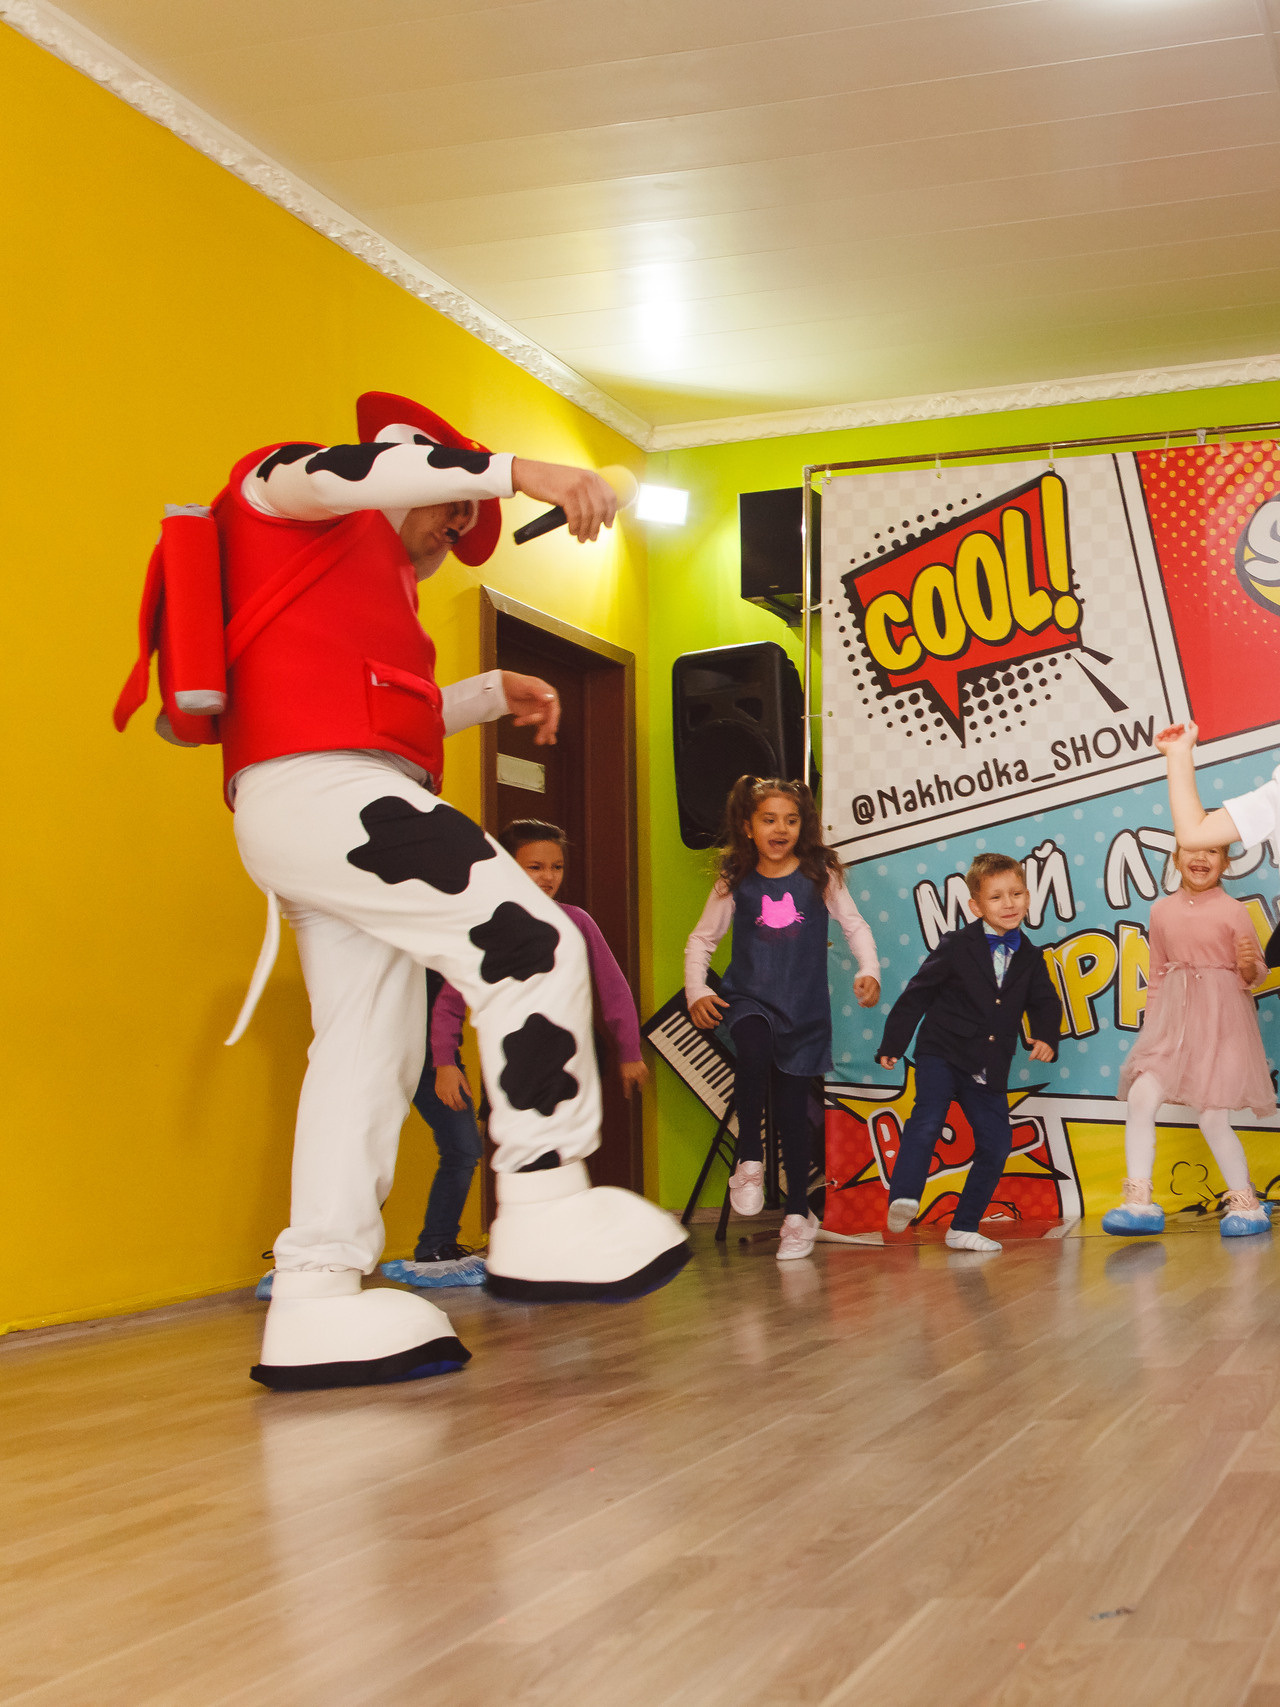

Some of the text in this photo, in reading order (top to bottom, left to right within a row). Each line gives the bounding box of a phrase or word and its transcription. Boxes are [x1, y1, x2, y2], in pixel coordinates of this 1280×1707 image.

[863, 473, 1081, 672] COOL!
[851, 714, 1156, 826] @Nakhodka_SHOW
[914, 840, 1076, 952] МЙ
